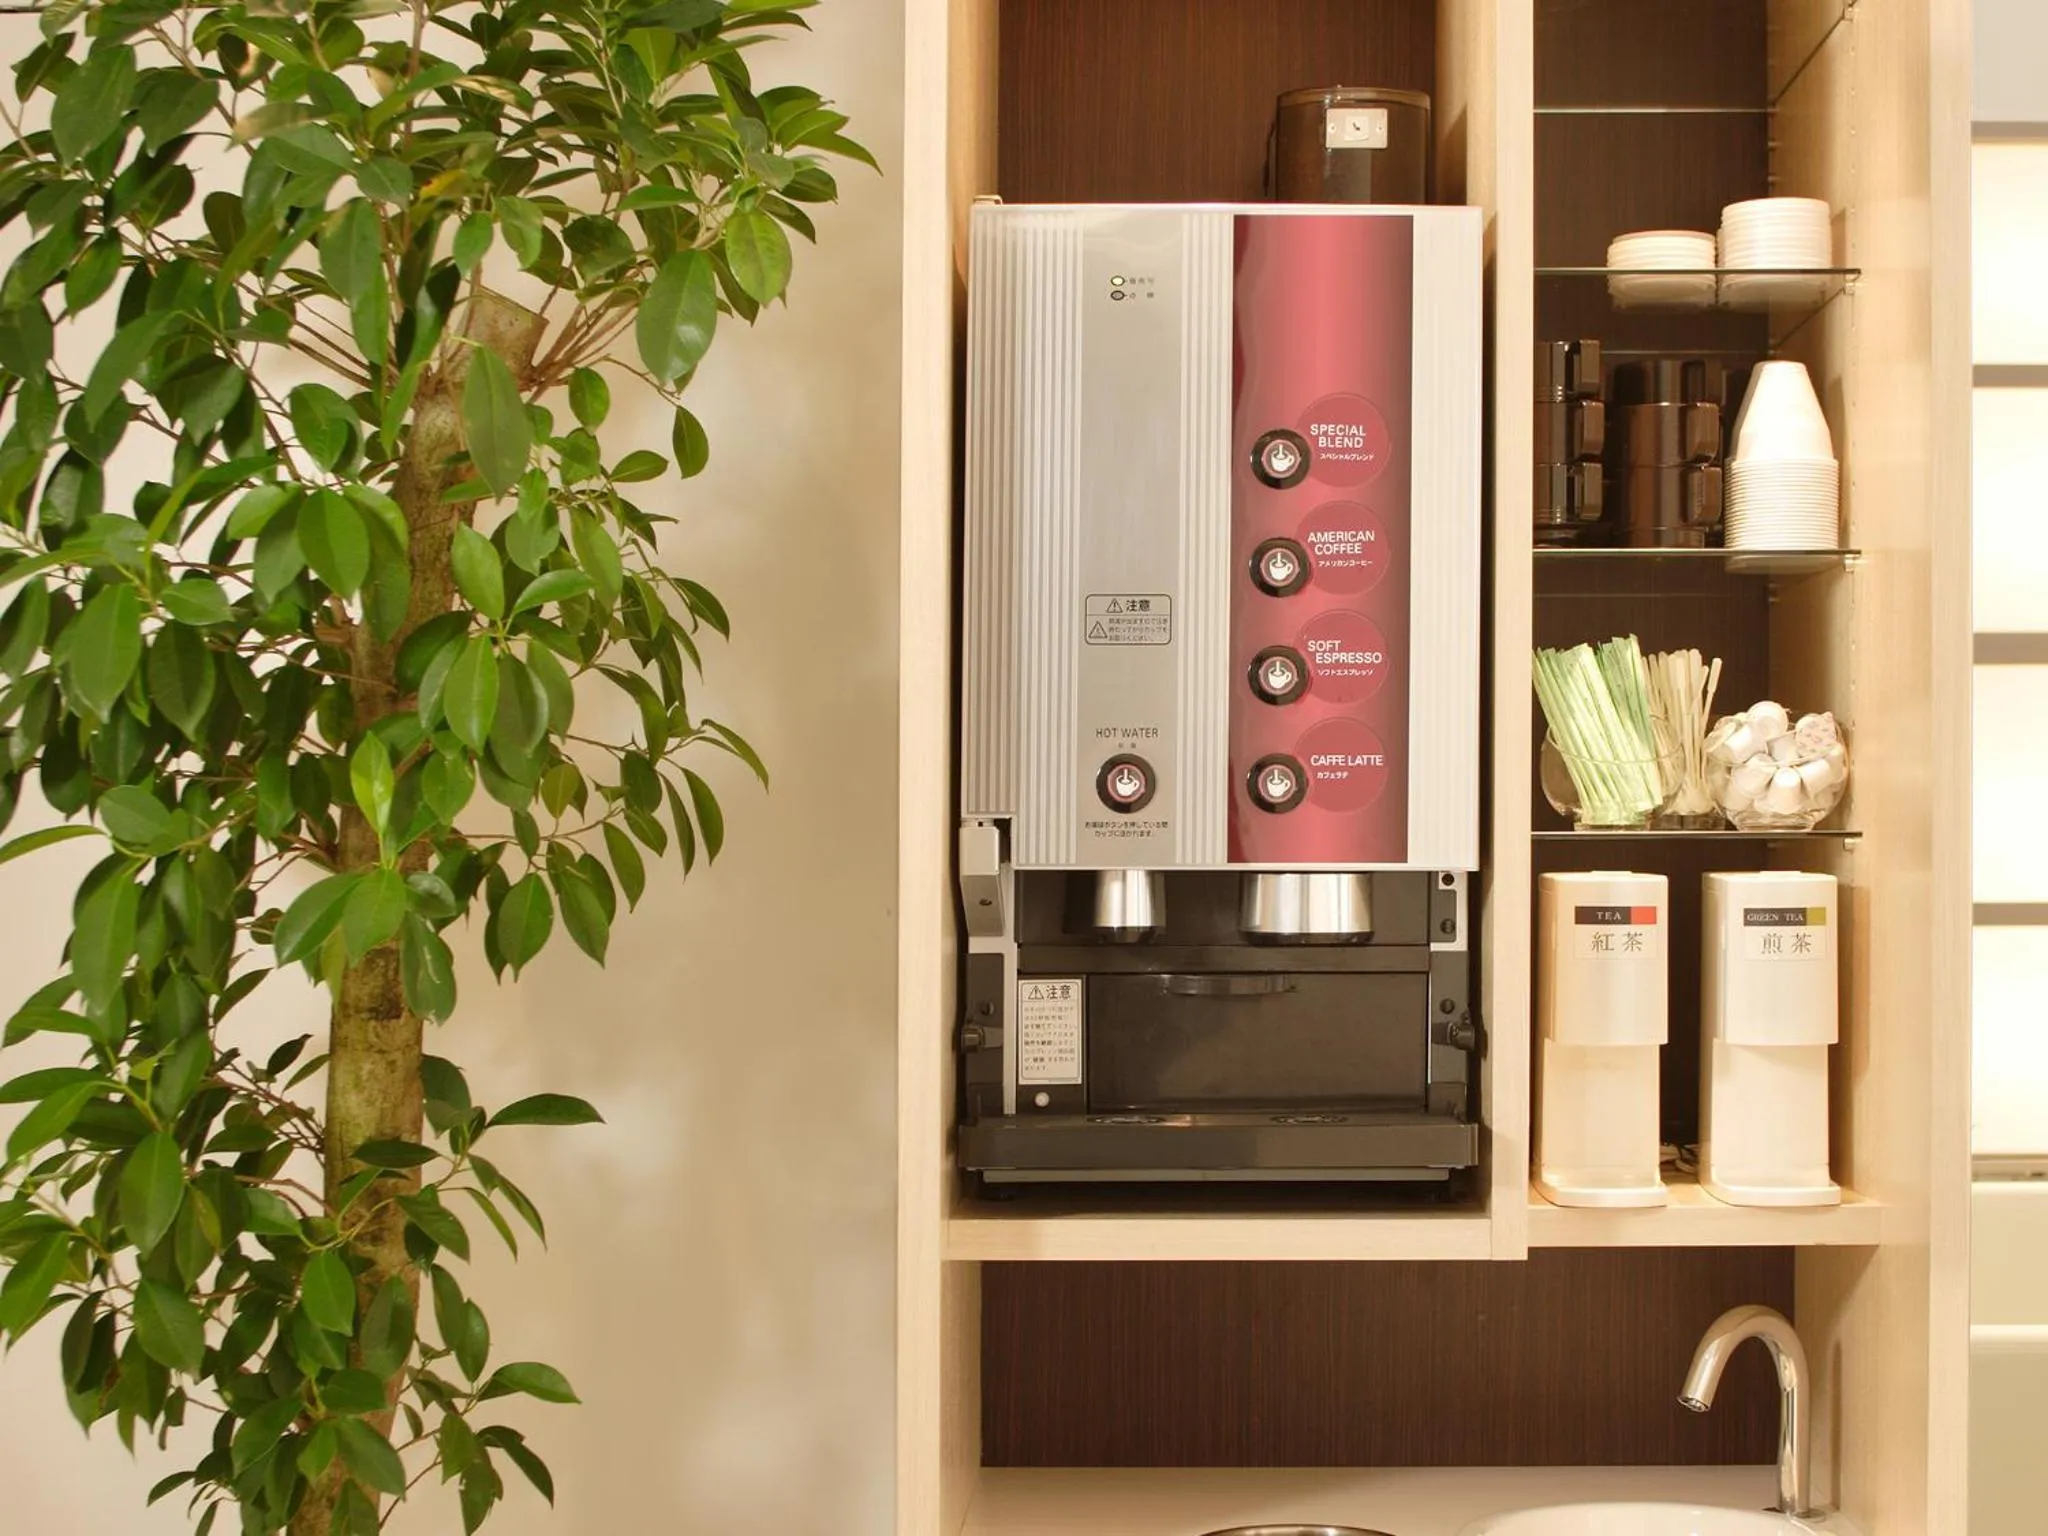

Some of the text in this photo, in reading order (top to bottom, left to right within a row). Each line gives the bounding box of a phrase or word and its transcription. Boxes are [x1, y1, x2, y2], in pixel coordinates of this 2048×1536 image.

[1310, 424, 1366, 436] SPECIAL
[1318, 436, 1364, 448] BLEND
[1307, 530, 1375, 543] AMERICAN
[1314, 543, 1362, 555] COFFEE
[1126, 600, 1150, 612] 注意
[1307, 640, 1342, 652] SOFT
[1315, 652, 1383, 664] ESPRESSO
[1096, 728, 1159, 738] HOT WATER
[1310, 755, 1384, 766] CAFFE LATTE
[1596, 911, 1622, 921] TEA
[1746, 913, 1804, 922] GREEN TEA
[1590, 931, 1644, 953] 紅茶
[1760, 932, 1812, 955] 煎茶
[1046, 985, 1072, 1000] 注意
